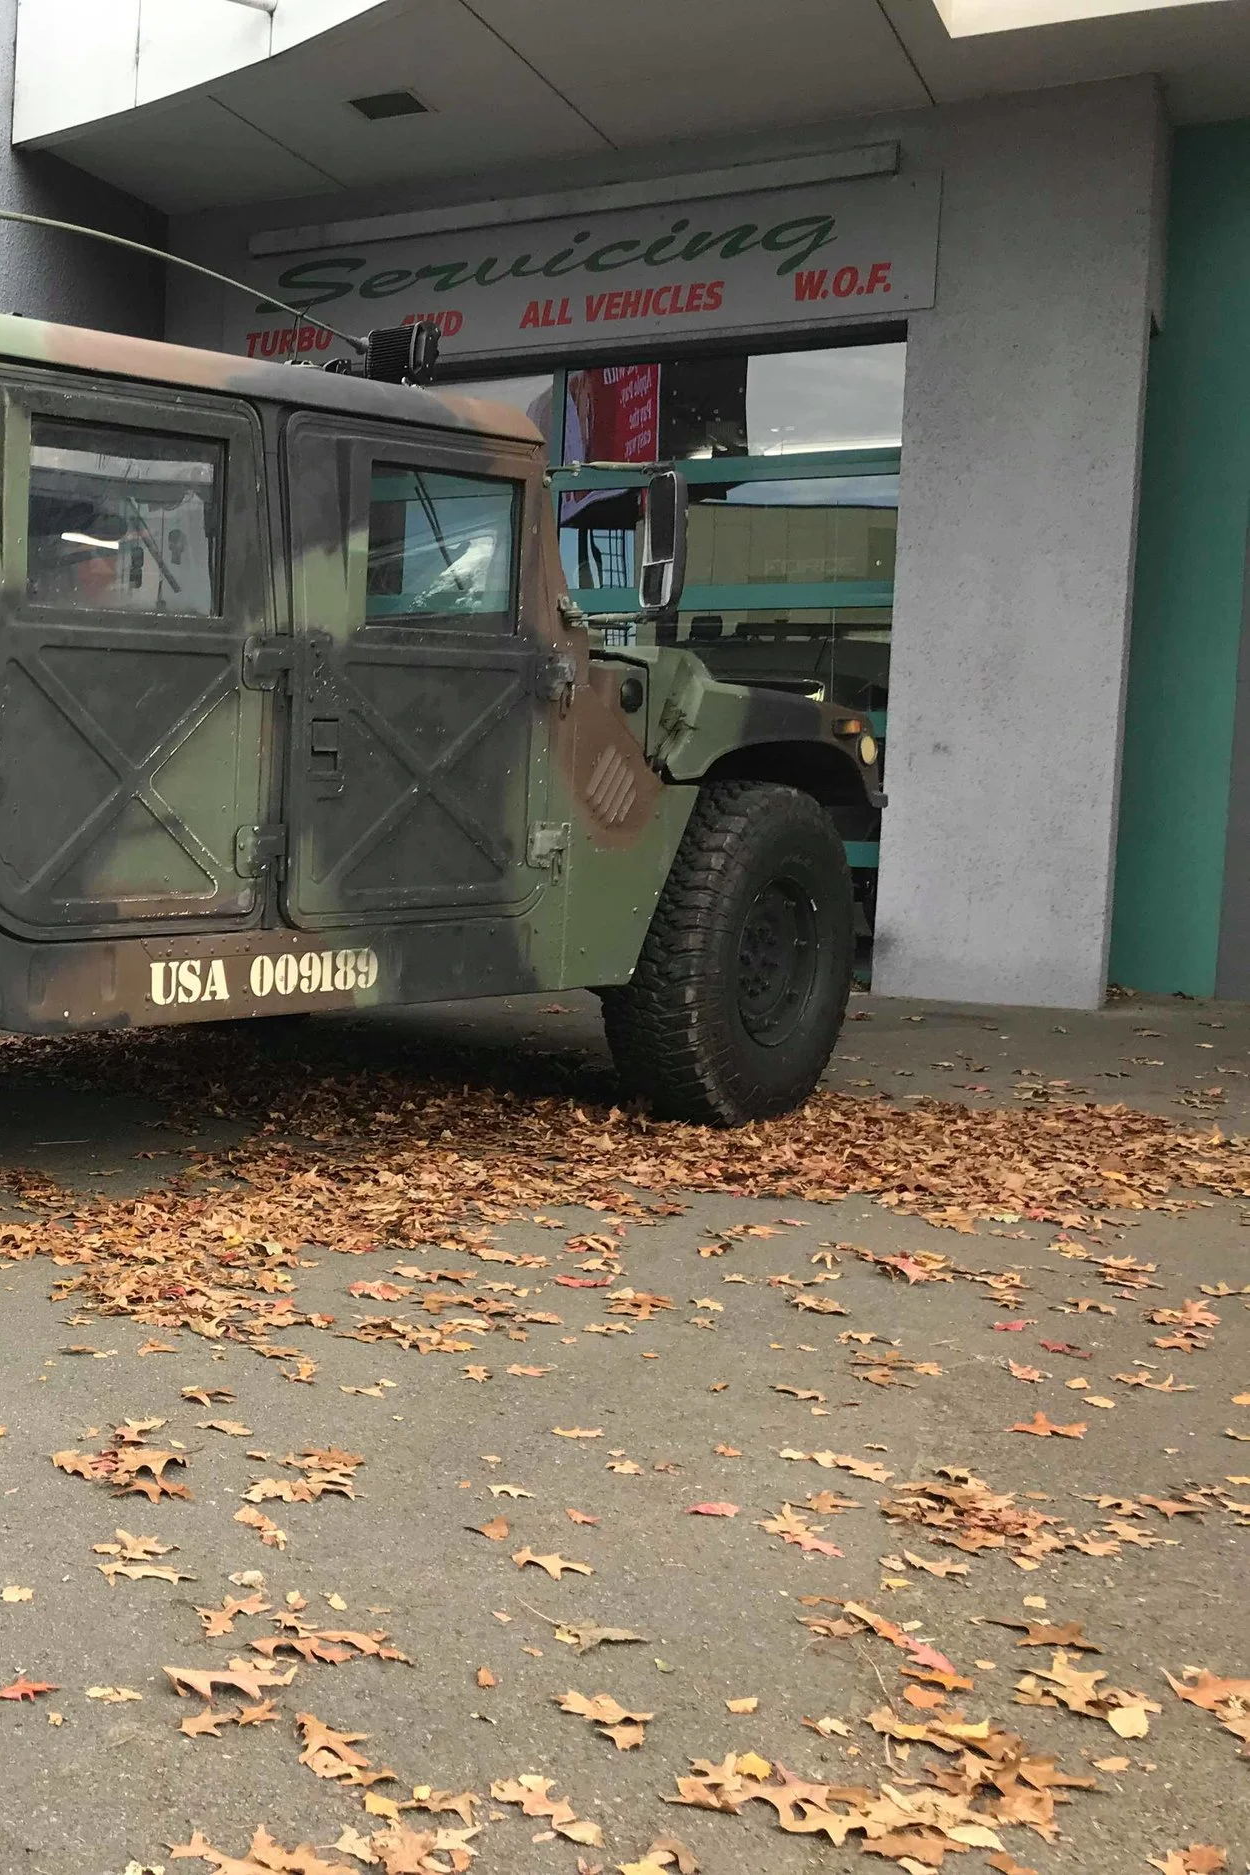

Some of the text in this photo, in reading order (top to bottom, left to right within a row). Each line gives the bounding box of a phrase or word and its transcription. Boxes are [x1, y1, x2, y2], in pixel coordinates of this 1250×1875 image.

[246, 324, 333, 358] TURBO
[520, 298, 572, 329] ALL
[584, 281, 725, 322] VEHICLES
[795, 262, 892, 302] W.O.F.
[254, 215, 838, 315] Servicing
[150, 948, 379, 1005] USA 009189
